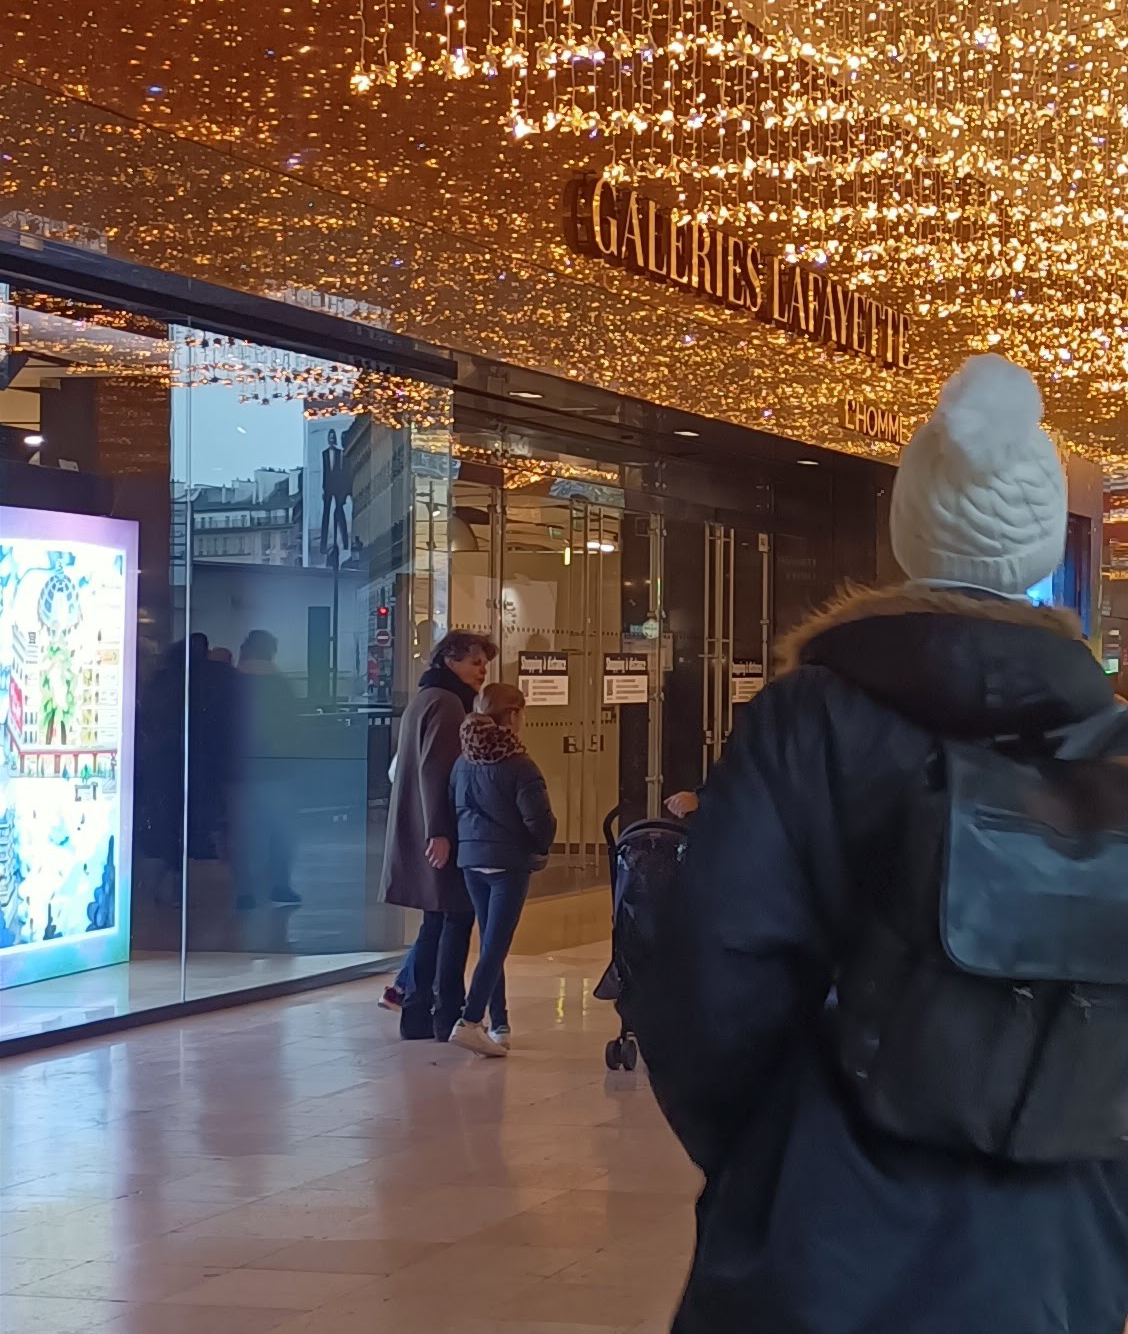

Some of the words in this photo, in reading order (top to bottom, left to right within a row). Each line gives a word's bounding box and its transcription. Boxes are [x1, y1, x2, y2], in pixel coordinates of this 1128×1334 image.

[592, 177, 762, 312] GALERIES
[773, 256, 912, 369] LAFAYETTE
[845, 398, 910, 445] L'HOMME
